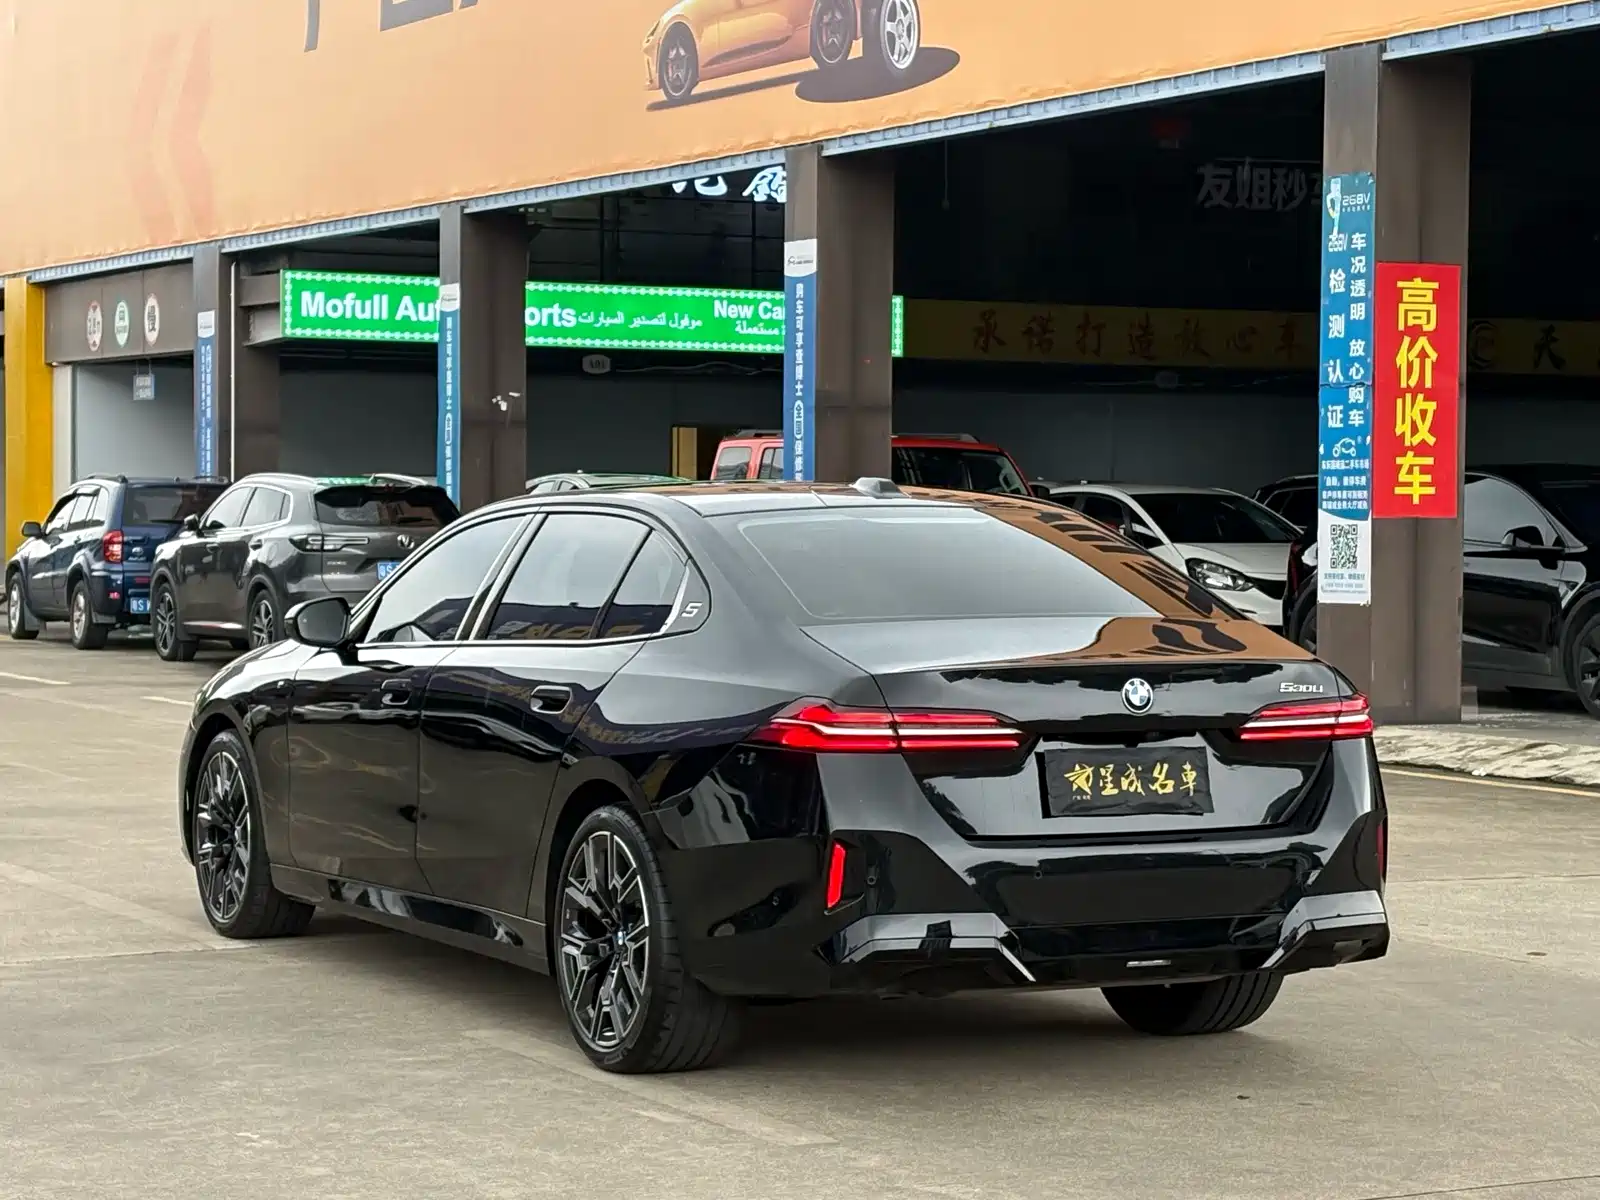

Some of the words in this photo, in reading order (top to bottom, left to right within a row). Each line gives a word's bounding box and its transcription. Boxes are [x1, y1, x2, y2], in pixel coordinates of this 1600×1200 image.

[1342, 192, 1370, 206] 268V
[301, 291, 388, 320] Mofull
[713, 300, 755, 319] New
[758, 301, 785, 320] Ca
[1349, 232, 1367, 321] 车况透明
[1327, 268, 1346, 428] 检测认证
[1348, 339, 1366, 427] 放心购车
[1394, 277, 1440, 505] 高价收车
